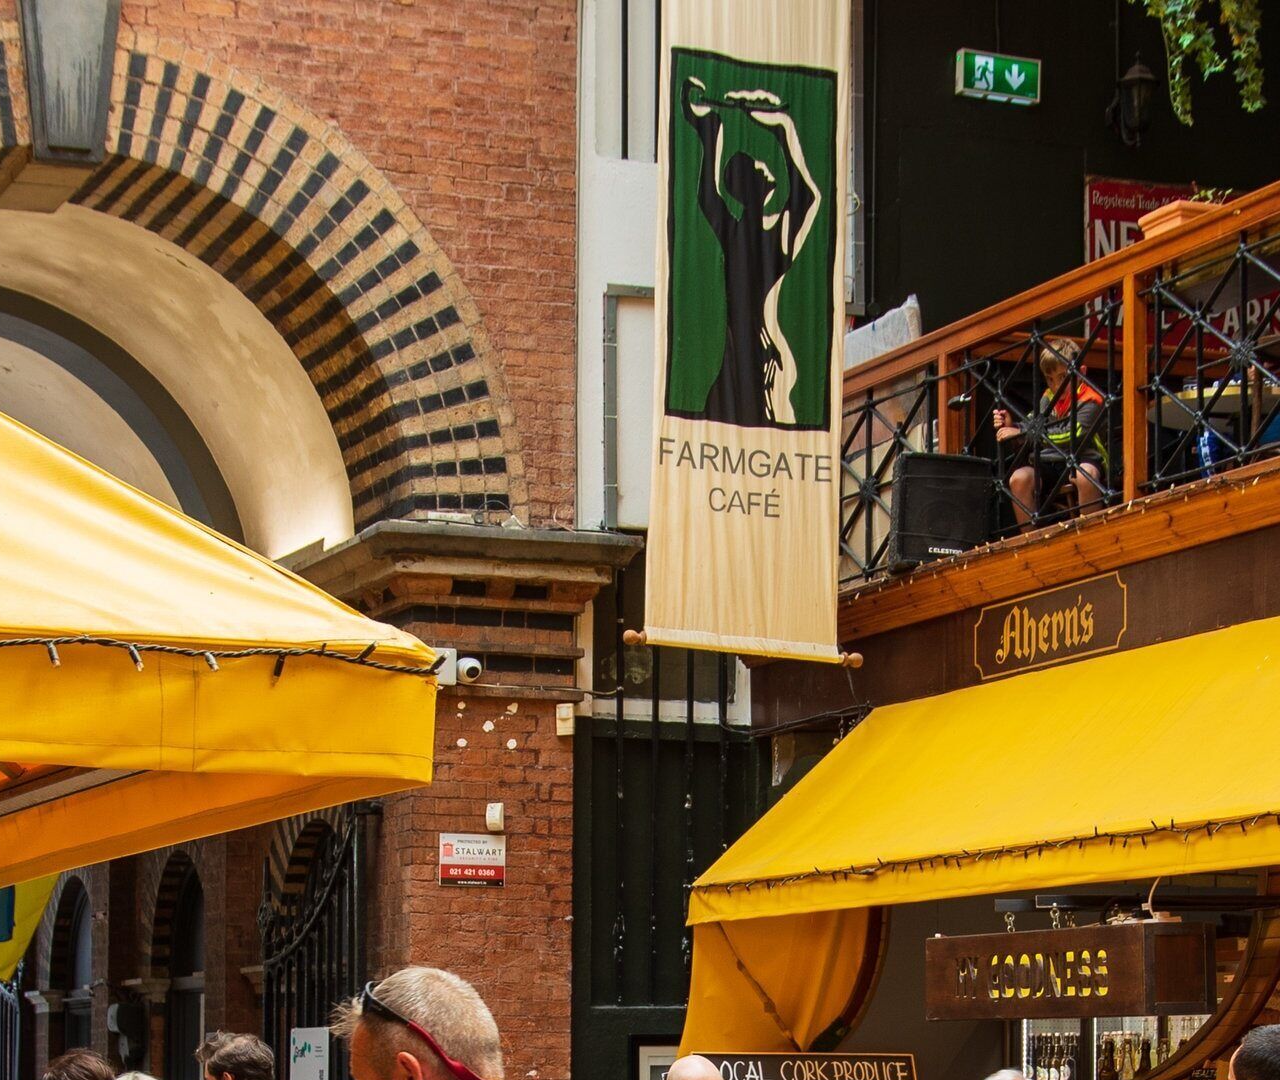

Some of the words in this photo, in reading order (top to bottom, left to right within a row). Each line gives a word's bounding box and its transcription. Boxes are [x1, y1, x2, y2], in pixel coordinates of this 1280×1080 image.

[1092, 190, 1135, 209] Registered
[1136, 195, 1160, 208] Trade
[658, 436, 833, 484] FARMGATE
[708, 485, 780, 519] CAFÉ
[995, 594, 1094, 665] Ahern's
[455, 847, 503, 856] STALWART
[464, 868, 475, 876] 421
[987, 950, 1109, 999] GOODNESS
